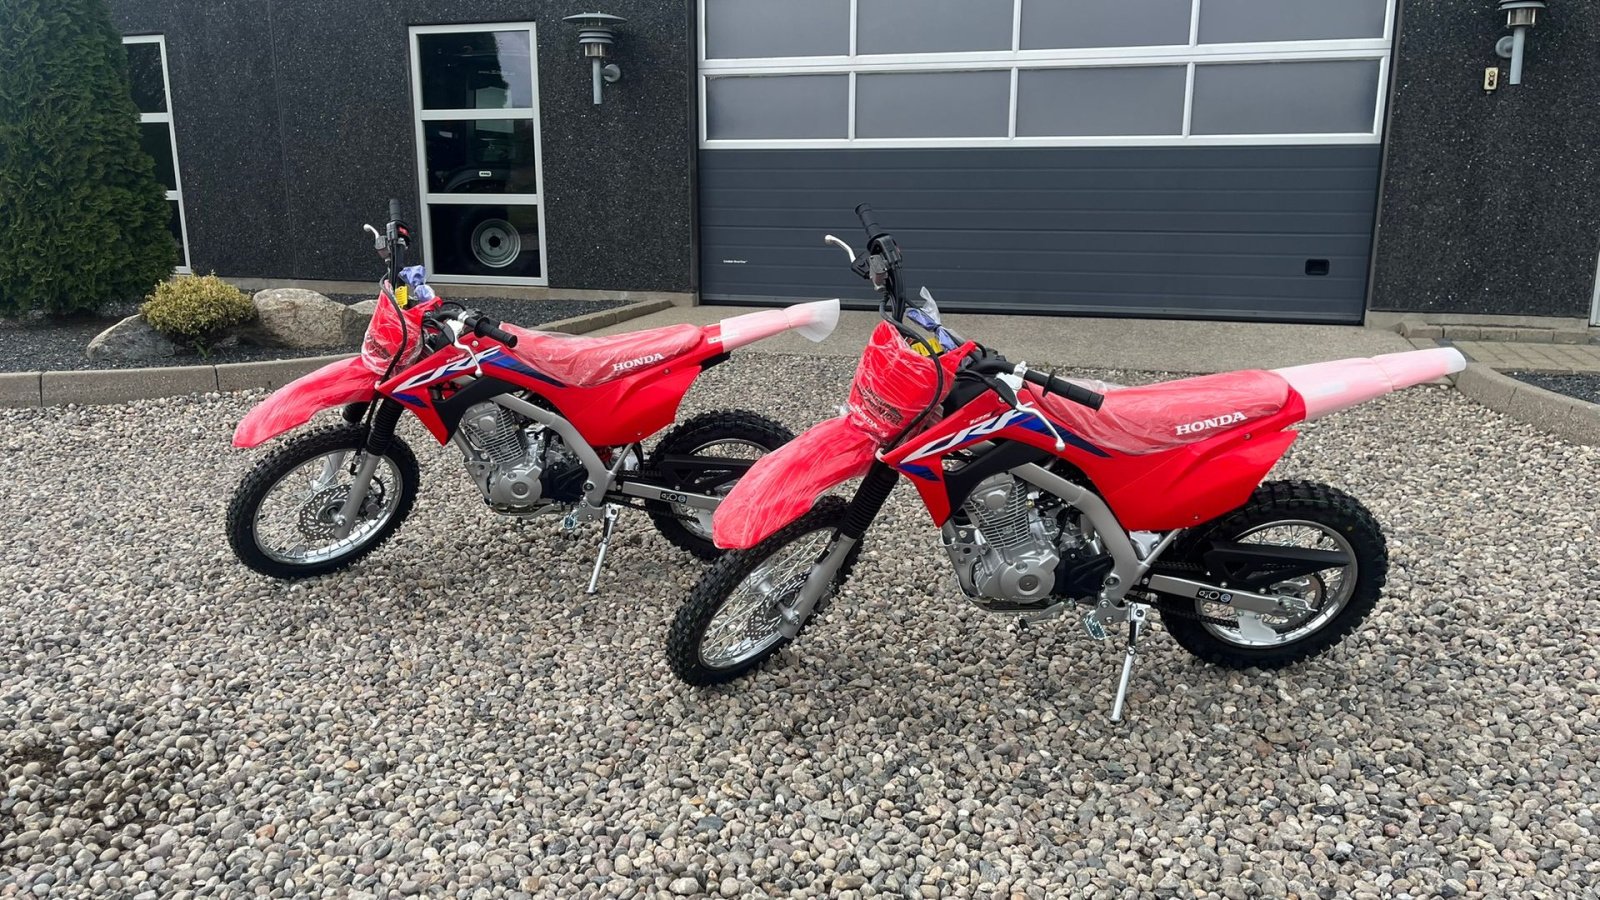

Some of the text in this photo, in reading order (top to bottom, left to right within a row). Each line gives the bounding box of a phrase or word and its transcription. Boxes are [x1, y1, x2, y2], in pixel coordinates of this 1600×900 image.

[392, 344, 502, 394] CRF
[612, 352, 665, 371] HONDA
[899, 401, 1035, 464] CRF
[1175, 411, 1249, 436] HONDA
